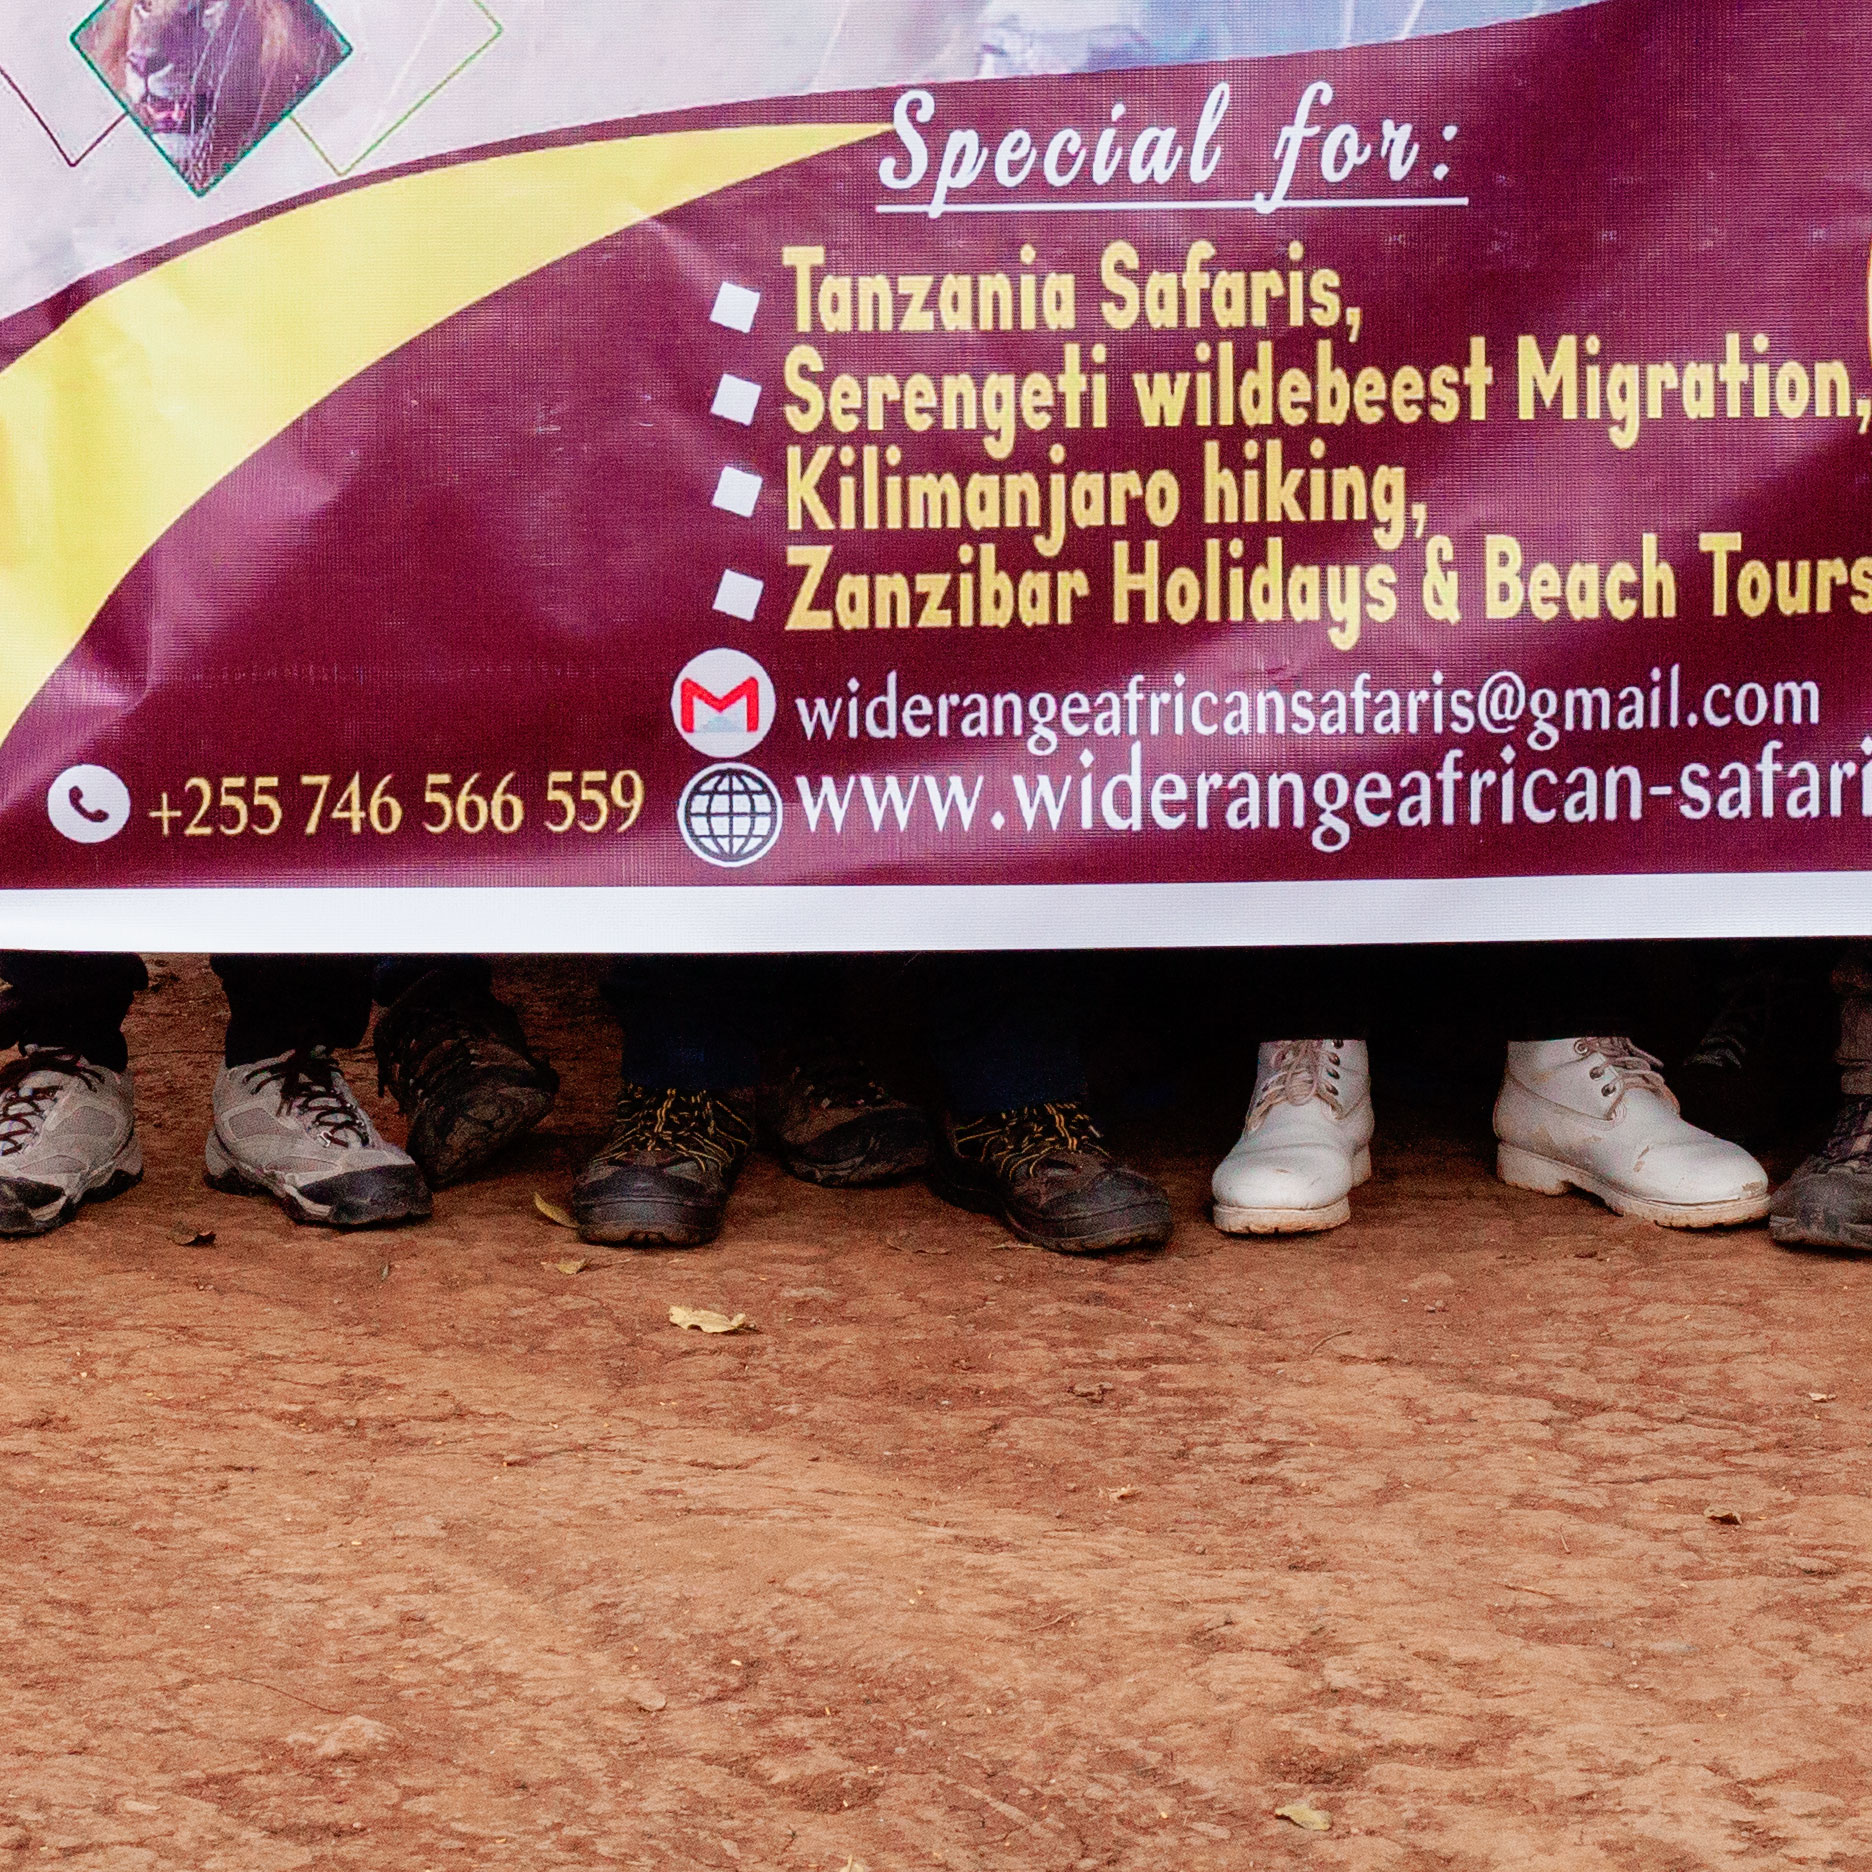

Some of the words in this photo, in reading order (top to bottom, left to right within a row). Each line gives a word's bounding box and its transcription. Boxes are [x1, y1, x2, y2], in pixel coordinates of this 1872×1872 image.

[879, 83, 1224, 216] Special
[1252, 81, 1456, 216] for:
[782, 243, 1077, 332] Tanzania
[1099, 239, 1363, 343] Safaris,
[783, 341, 1109, 460] Serengeti
[1133, 335, 1492, 428] wildebeest
[1516, 332, 1872, 450] Migration,
[786, 442, 1181, 558] Kilimanjaro
[1203, 436, 1428, 550] hiking,
[784, 544, 1090, 631] Zanzibar
[1112, 535, 1399, 651] Holidays
[1422, 534, 1462, 626] &
[1484, 531, 1678, 622] Beach
[795, 662, 1821, 757] widerangeafricansafaris@gmail.com
[148, 775, 283, 838] +255
[299, 772, 403, 835] 746
[422, 770, 524, 834] 566
[544, 768, 646, 836] 559
